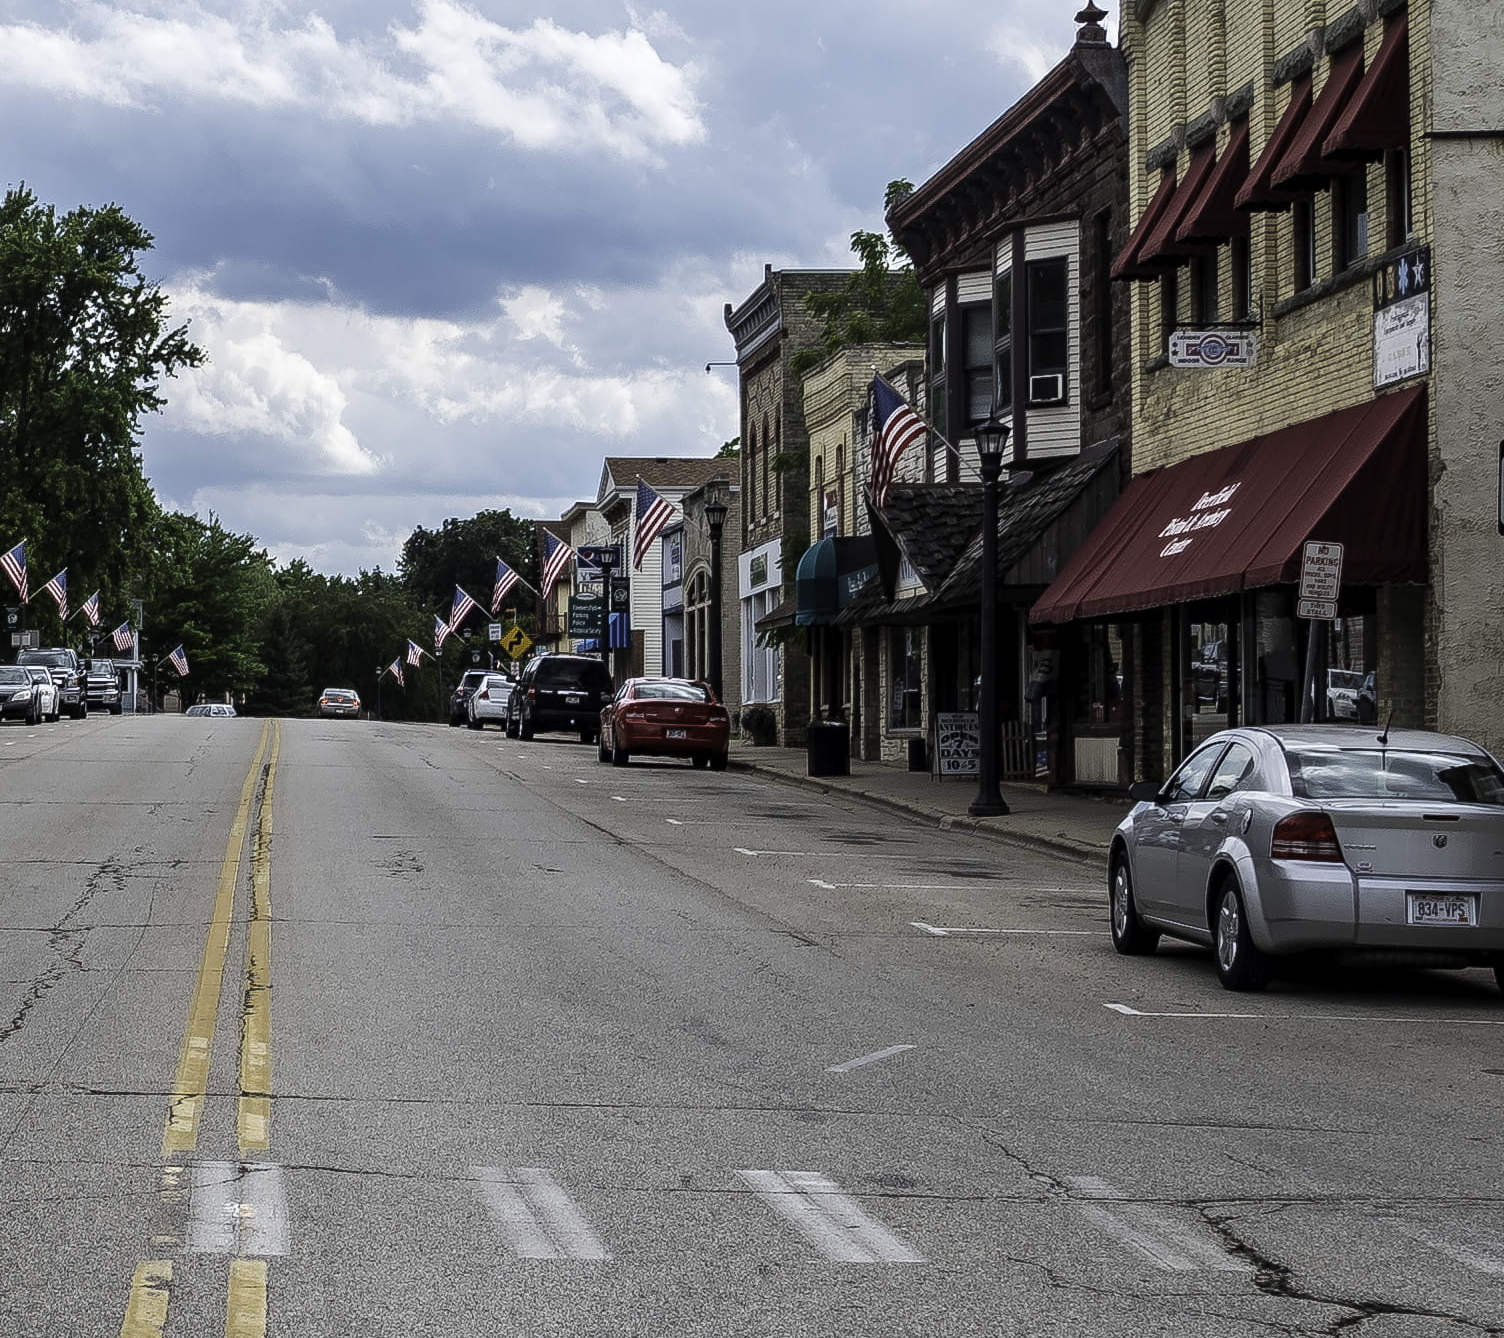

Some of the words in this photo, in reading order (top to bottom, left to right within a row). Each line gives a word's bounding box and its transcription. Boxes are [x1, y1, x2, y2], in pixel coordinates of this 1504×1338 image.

[1190, 482, 1242, 512] Deerfield
[1318, 546, 1329, 556] NO
[1306, 556, 1339, 567] PARKING
[1306, 608, 1329, 616] STALL
[940, 731, 980, 745] OPEN
[954, 740, 964, 749] 7
[940, 749, 981, 758] DAYS
[1418, 901, 1466, 918] 834-VPS
